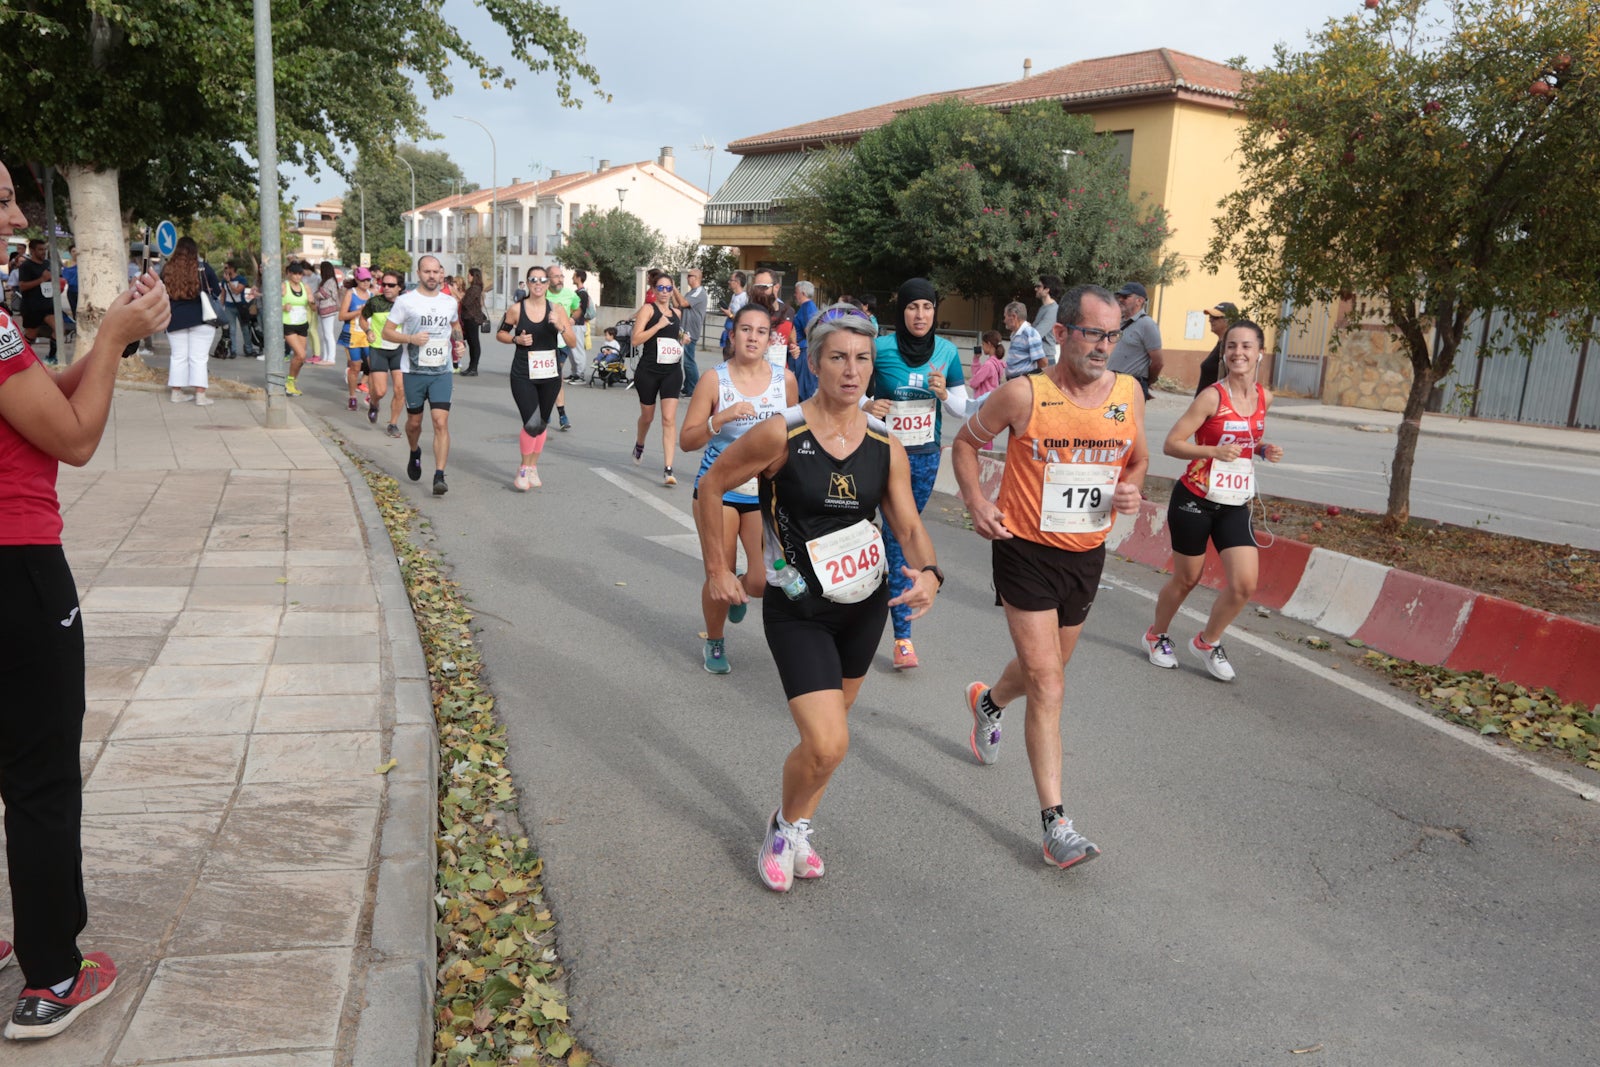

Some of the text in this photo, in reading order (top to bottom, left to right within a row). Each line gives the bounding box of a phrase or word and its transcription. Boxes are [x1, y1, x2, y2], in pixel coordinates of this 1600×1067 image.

[426, 347, 443, 357] 694
[661, 346, 681, 355] 2056
[532, 359, 554, 369] 2165
[892, 414, 932, 431] 2034
[1032, 439, 1060, 463] LA
[1043, 438, 1070, 448] Club
[1215, 473, 1250, 490] 2101
[1062, 487, 1102, 509] 179
[825, 543, 881, 585] 2048
